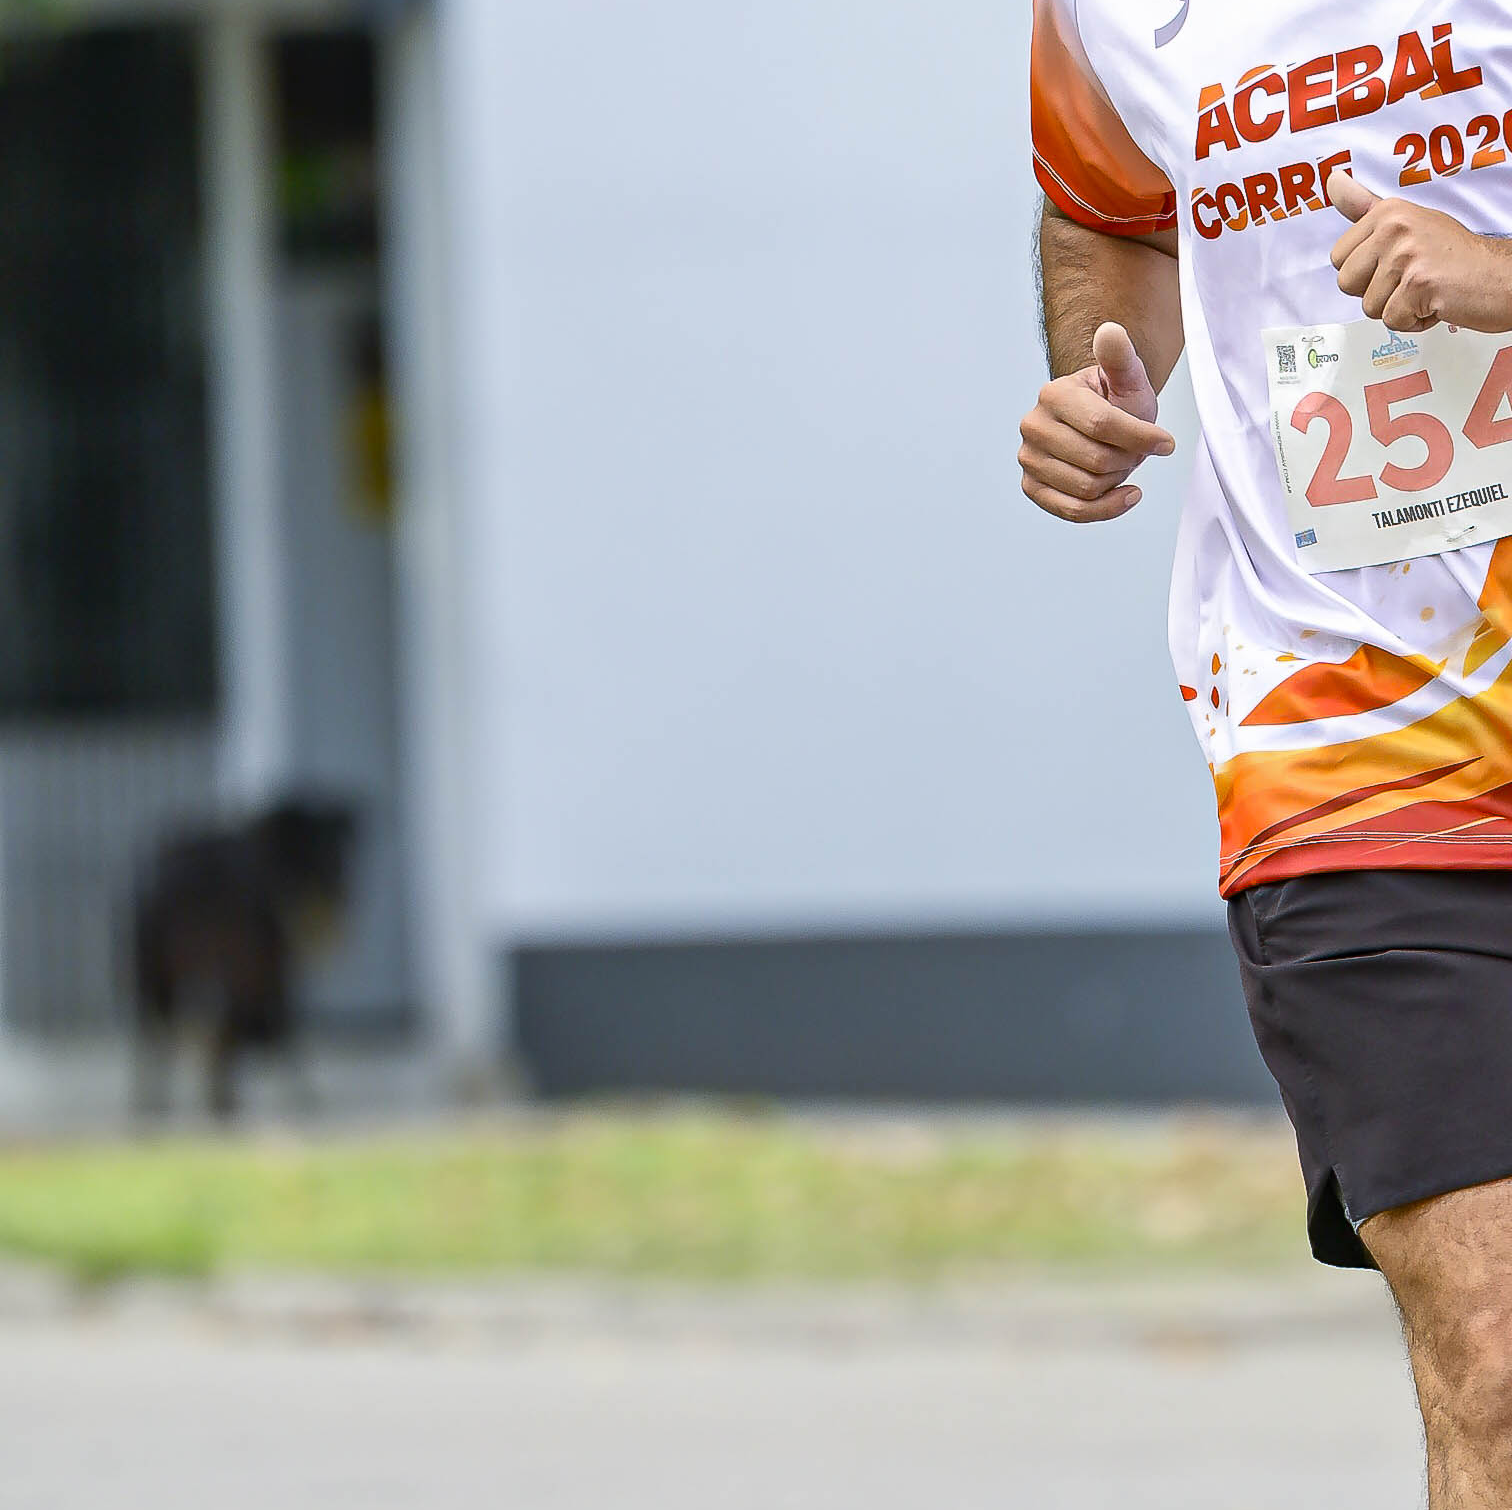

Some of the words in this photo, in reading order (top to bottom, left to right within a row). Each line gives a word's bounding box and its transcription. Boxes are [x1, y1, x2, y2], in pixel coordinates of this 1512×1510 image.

[1195, 22, 1483, 161] ACEBAL
[1372, 499, 1446, 529] TALAMONTI
[1445, 483, 1509, 514] EZEQUIEL
